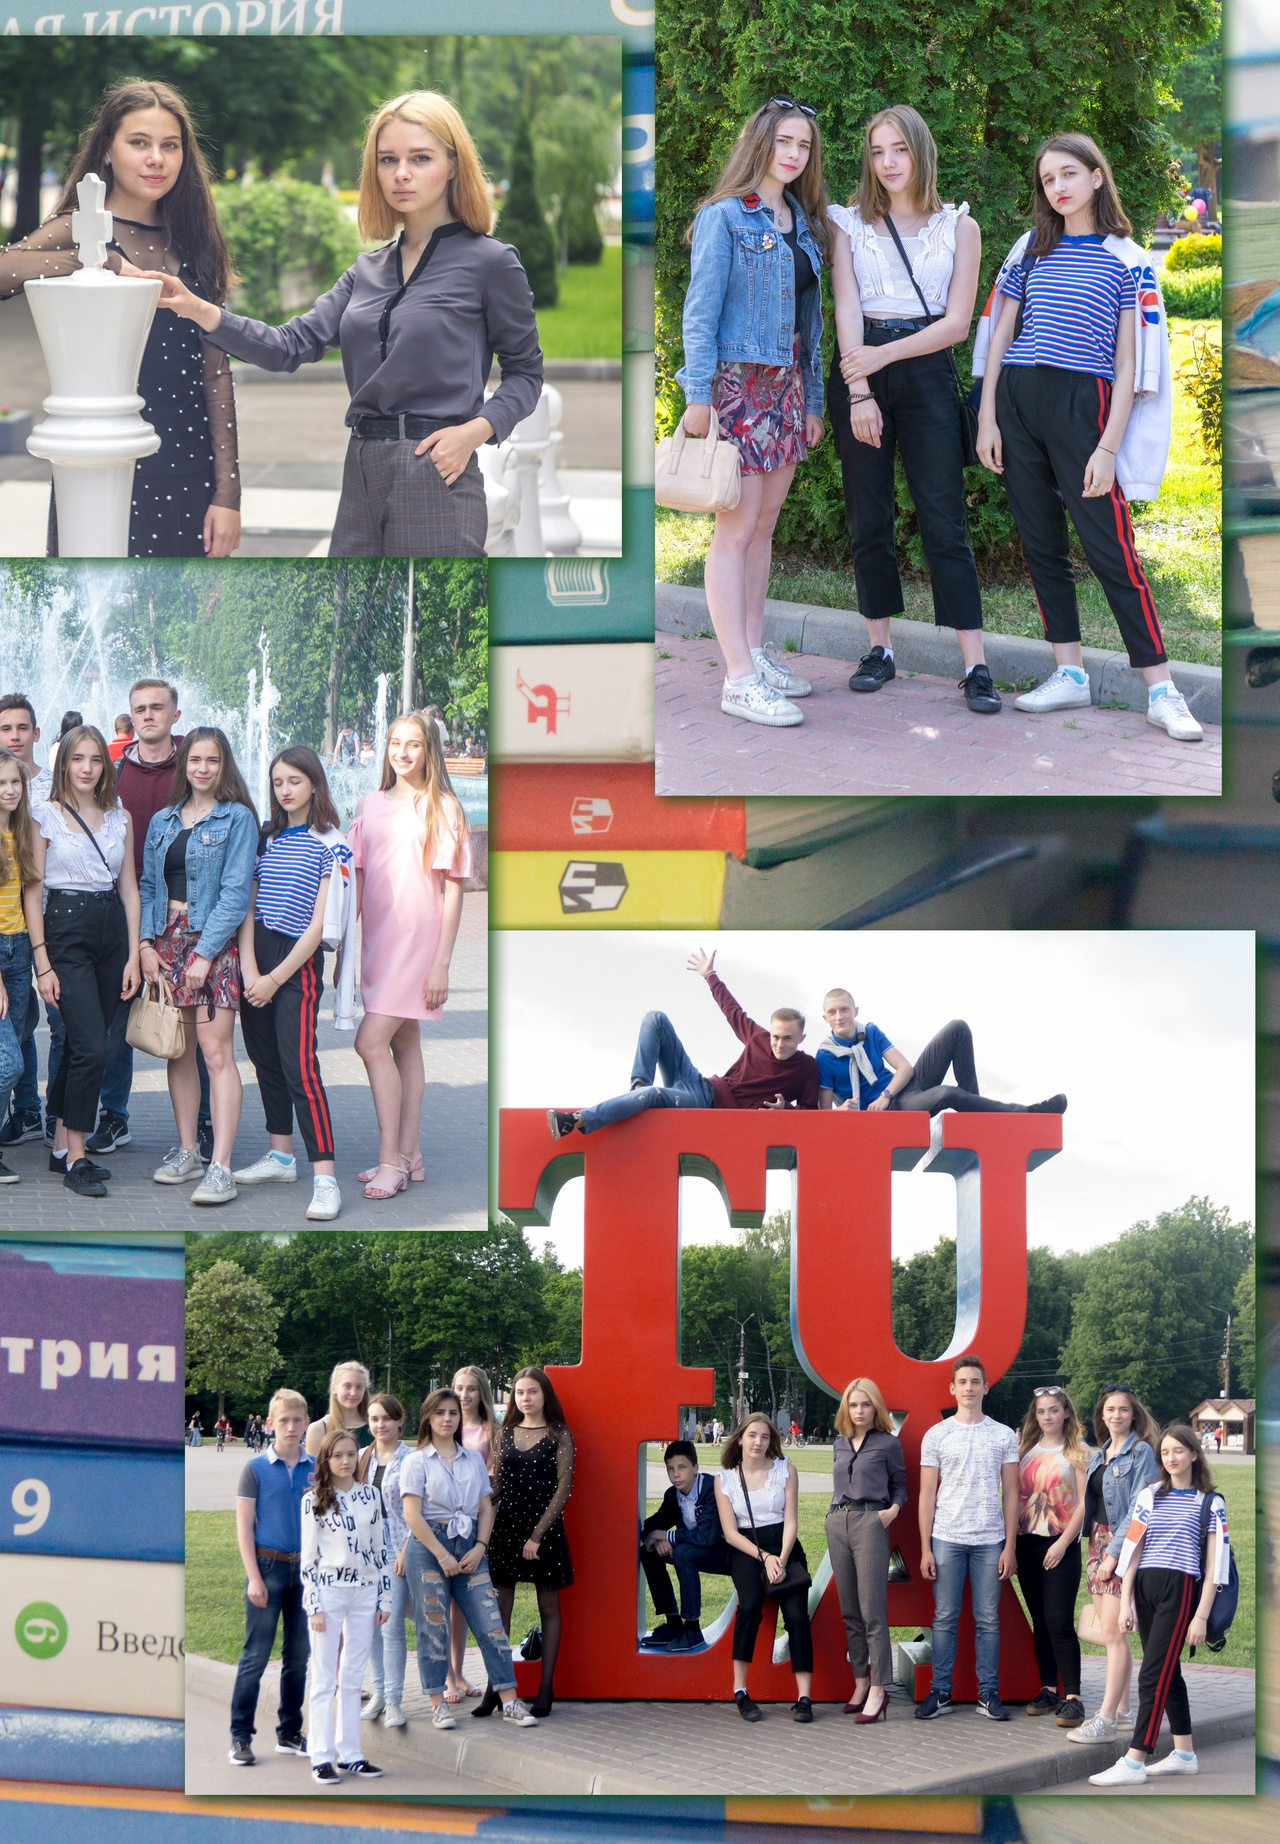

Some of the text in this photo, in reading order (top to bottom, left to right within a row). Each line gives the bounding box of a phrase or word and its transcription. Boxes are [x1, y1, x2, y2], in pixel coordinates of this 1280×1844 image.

[82, 0, 346, 36] ИСТОРИЯ
[11, 1479, 51, 1536] 9
[23, 1617, 59, 1644] 9
